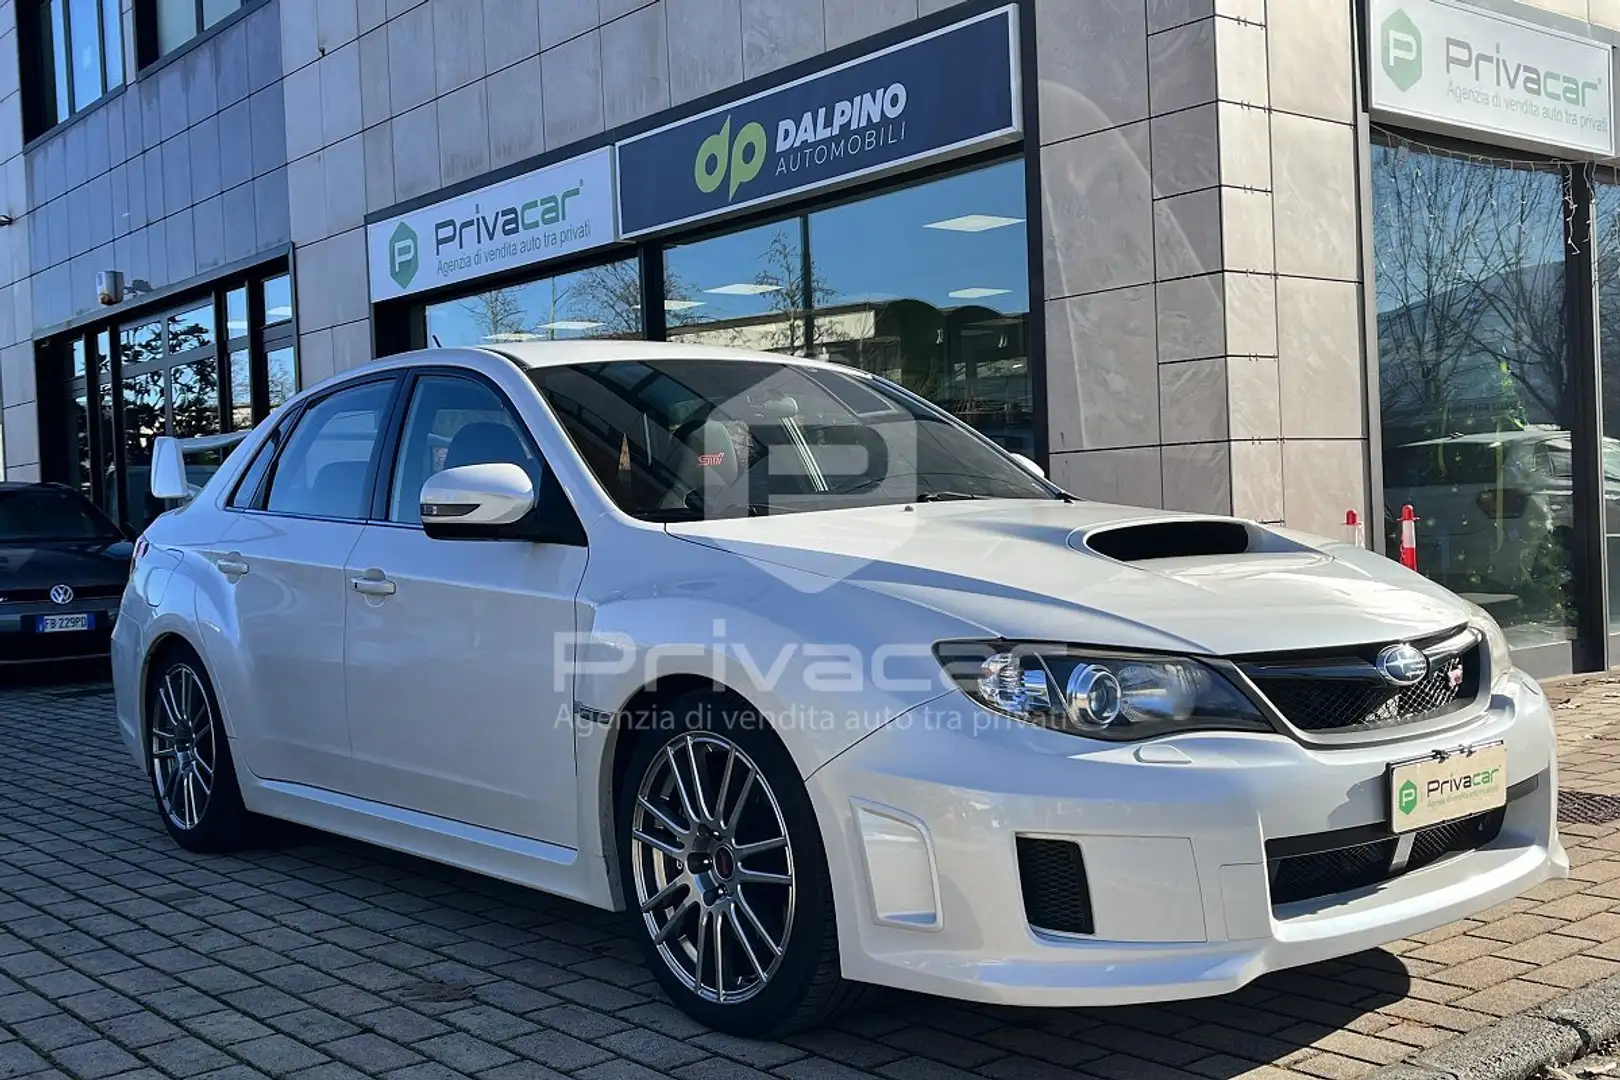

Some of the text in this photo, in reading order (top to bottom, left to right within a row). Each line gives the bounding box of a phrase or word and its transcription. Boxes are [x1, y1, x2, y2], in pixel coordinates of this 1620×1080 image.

[1446, 37, 1598, 107] Privacar
[776, 83, 907, 152] DALPINO
[1447, 80, 1489, 105] Agenzia
[1492, 94, 1500, 108] di
[1501, 97, 1540, 117] vendita
[1542, 105, 1562, 122] auto
[1565, 109, 1578, 126] tra
[775, 121, 906, 176] AUTOMOBILI
[435, 187, 580, 255] Privacar
[437, 219, 591, 277] Agenzia di vendita auto tra privati
[1427, 768, 1500, 798] Privacar
